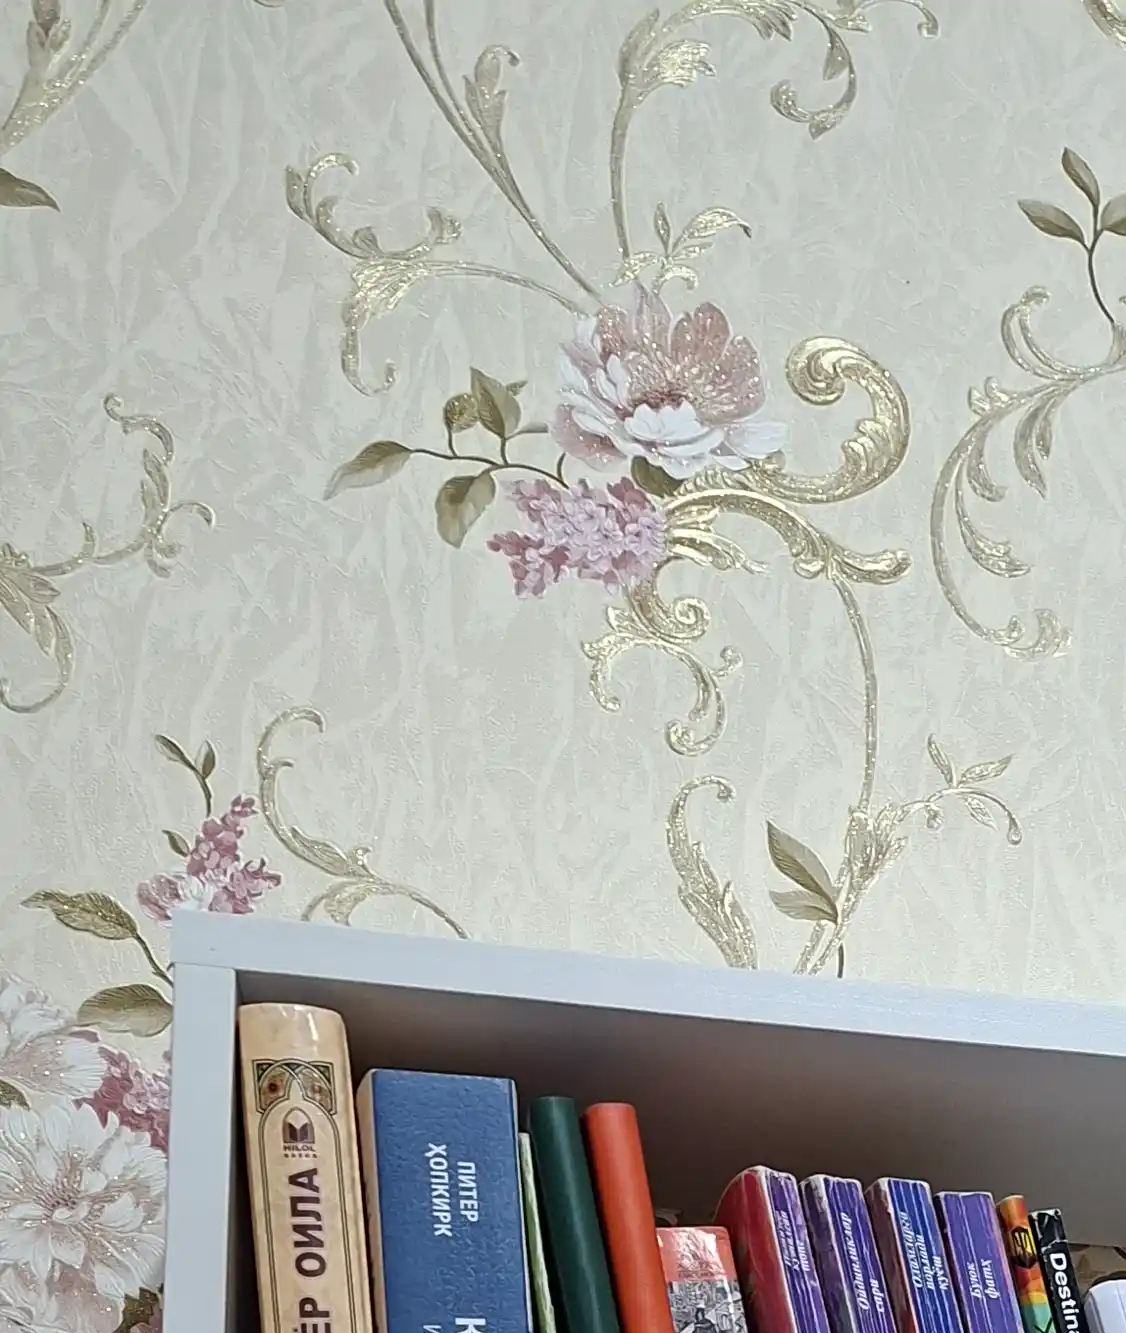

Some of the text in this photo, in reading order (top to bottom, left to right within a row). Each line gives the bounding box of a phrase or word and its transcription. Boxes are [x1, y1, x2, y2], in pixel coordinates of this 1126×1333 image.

[424, 1143, 452, 1237] ҲОПКИРК
[457, 1161, 479, 1223] ПИТЕР
[288, 1167, 326, 1278] ОИЛА
[870, 1279, 884, 1313] сари
[967, 1261, 983, 1299] Буюк
